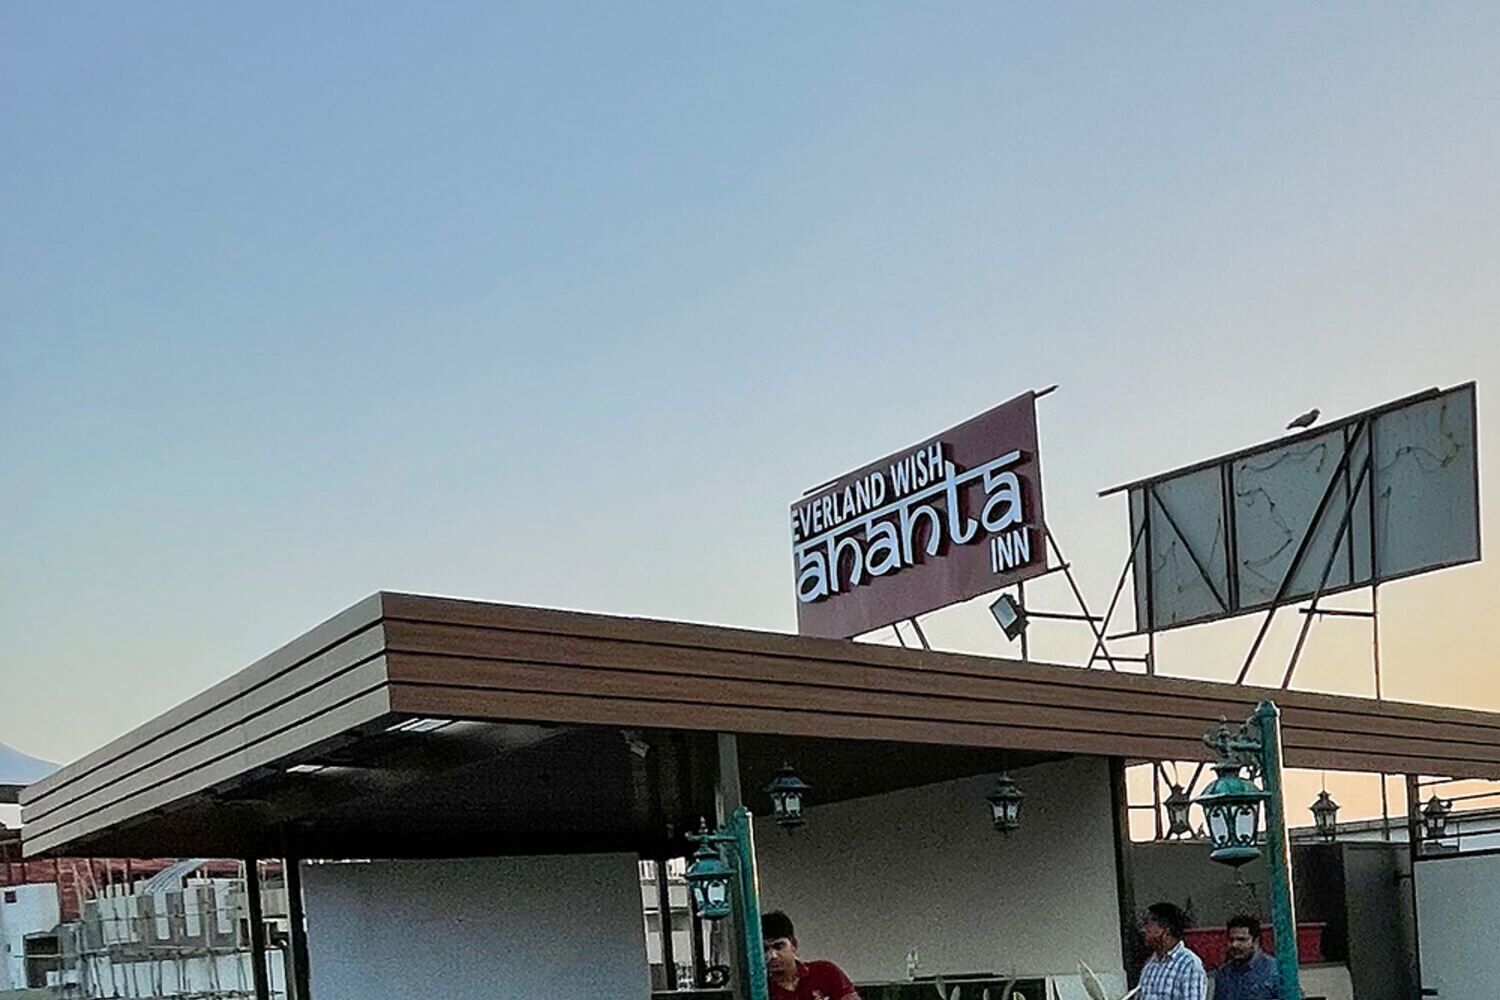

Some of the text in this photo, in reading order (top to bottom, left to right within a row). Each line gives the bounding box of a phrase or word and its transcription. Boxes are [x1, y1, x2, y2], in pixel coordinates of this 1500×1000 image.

[792, 441, 944, 542] EVERLAND WISH
[794, 449, 1023, 603] ananta
[990, 526, 1030, 573] INN
